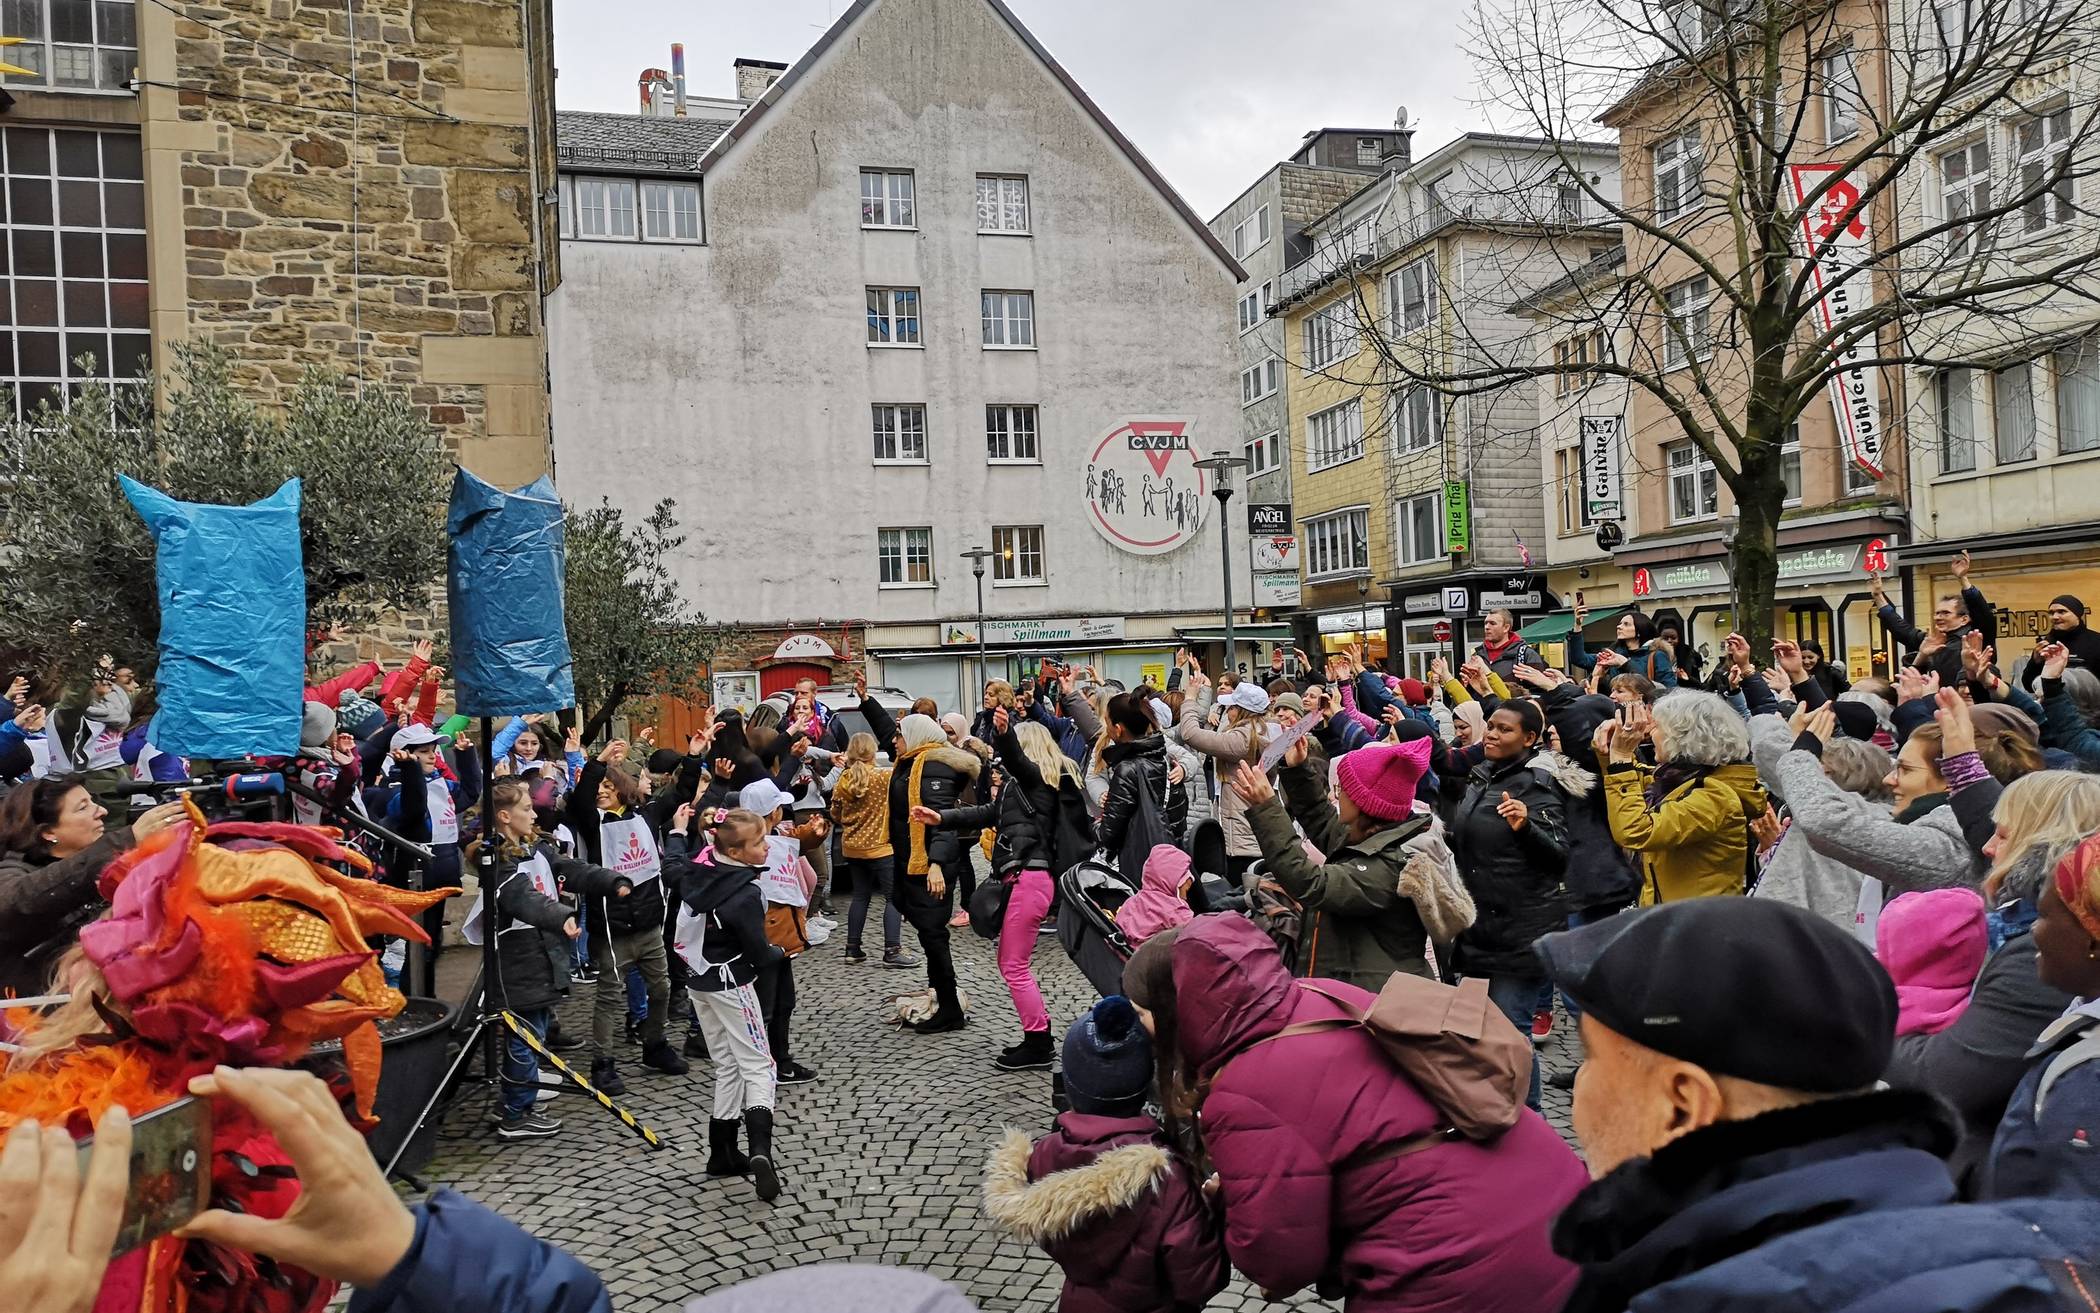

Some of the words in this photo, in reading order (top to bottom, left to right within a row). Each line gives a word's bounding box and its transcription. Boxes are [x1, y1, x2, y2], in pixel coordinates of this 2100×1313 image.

[1131, 436, 1186, 449] CVJM
[1449, 482, 1462, 508] Thai
[1253, 510, 1287, 524] ANGEL
[1450, 512, 1463, 537] Prig
[1665, 565, 1710, 585] mühlen
[1263, 580, 1299, 588] Spillmann
[1507, 578, 1526, 590] sky
[975, 621, 1046, 630] FRISCHMARKT
[1012, 628, 1071, 641] Spillmann
[785, 637, 822, 651] CVJM
